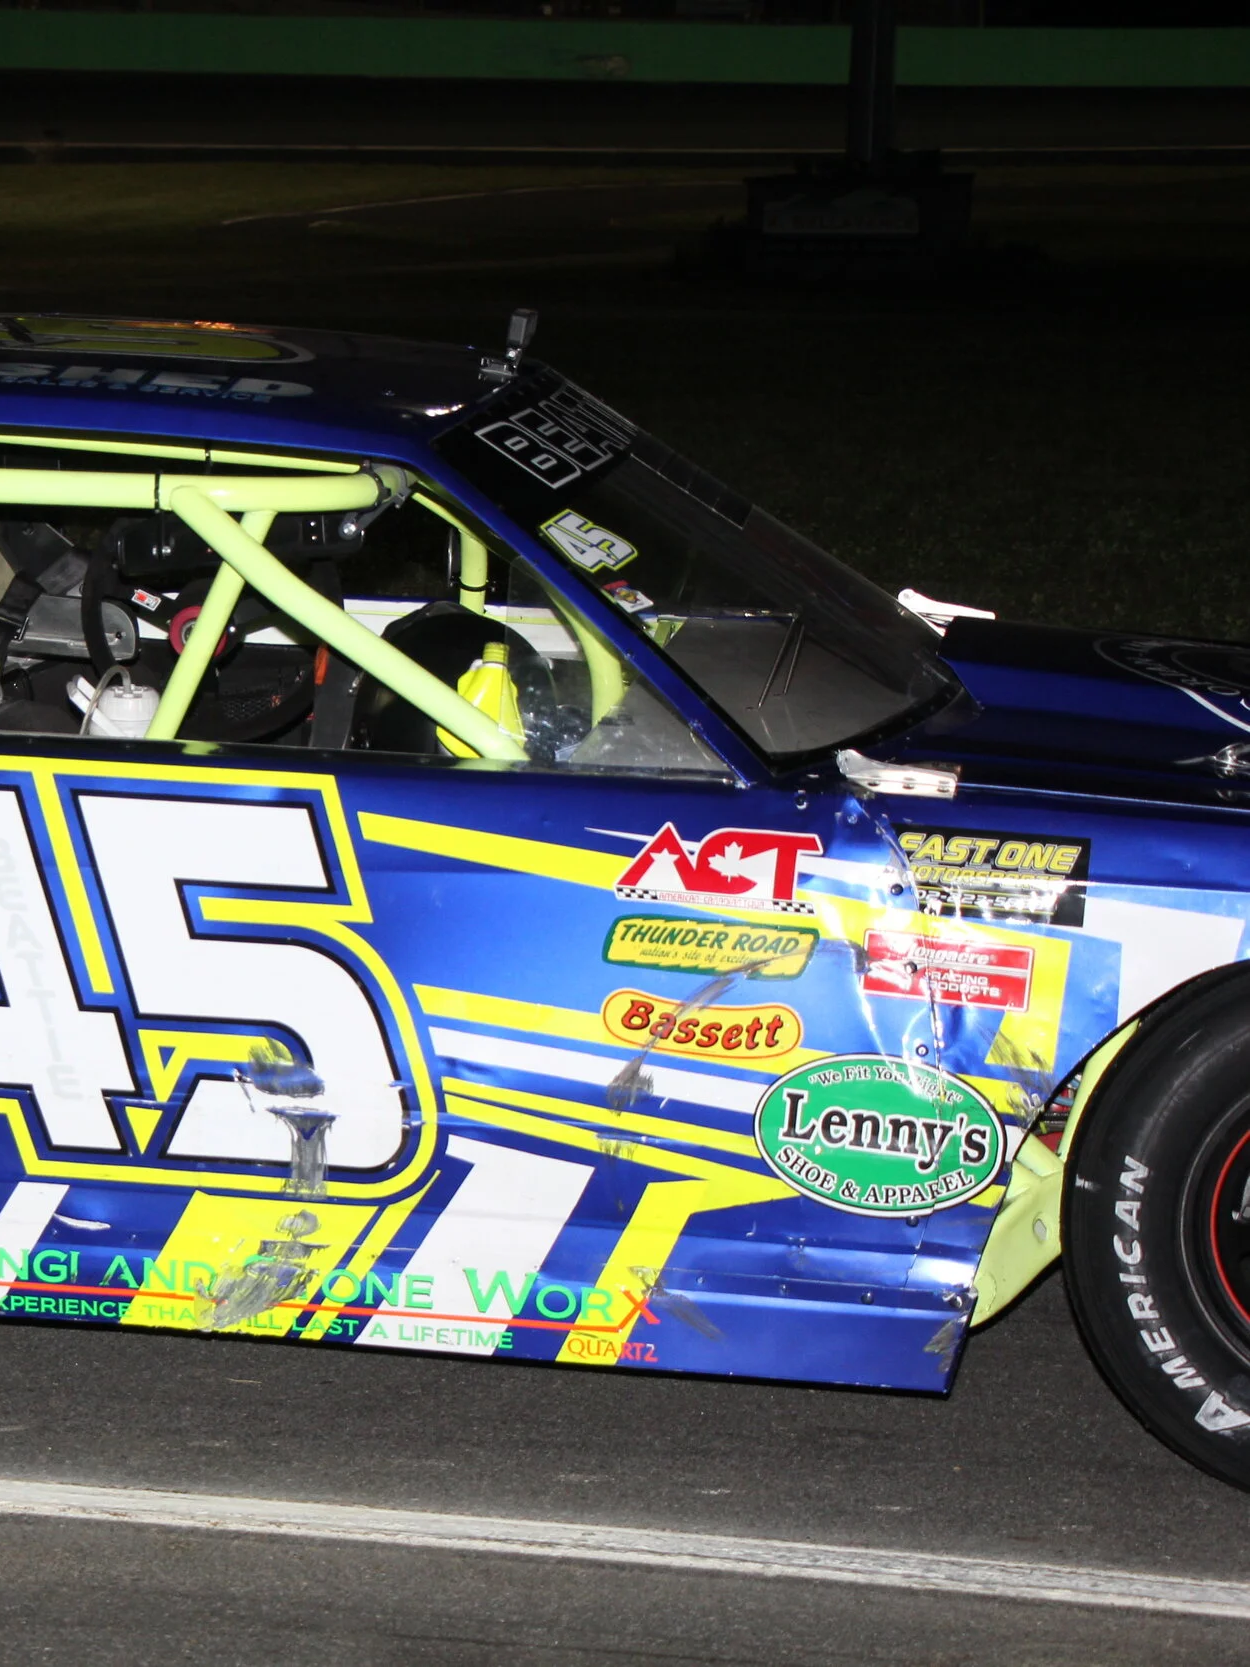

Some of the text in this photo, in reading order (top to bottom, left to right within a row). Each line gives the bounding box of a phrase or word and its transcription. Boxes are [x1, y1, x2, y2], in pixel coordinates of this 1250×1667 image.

[539, 509, 638, 572] 45
[617, 822, 823, 901] ACT
[898, 832, 1082, 874] FAST ONE
[620, 923, 800, 955] THUNDER ROAD
[621, 999, 784, 1050] Bassett
[844, 1065, 870, 1081] Fit
[780, 1090, 989, 1172] Lenny's
[777, 1146, 974, 1205] SHOE & APPAREL
[462, 1266, 660, 1325] WORX
[1113, 1155, 1250, 1432] AMERICAN
[139, 1303, 197, 1323] THA
[291, 1315, 359, 1336] LAST
[368, 1324, 390, 1339] A
[398, 1325, 514, 1351] LIFETIME
[567, 1338, 659, 1363] QUARTZ
